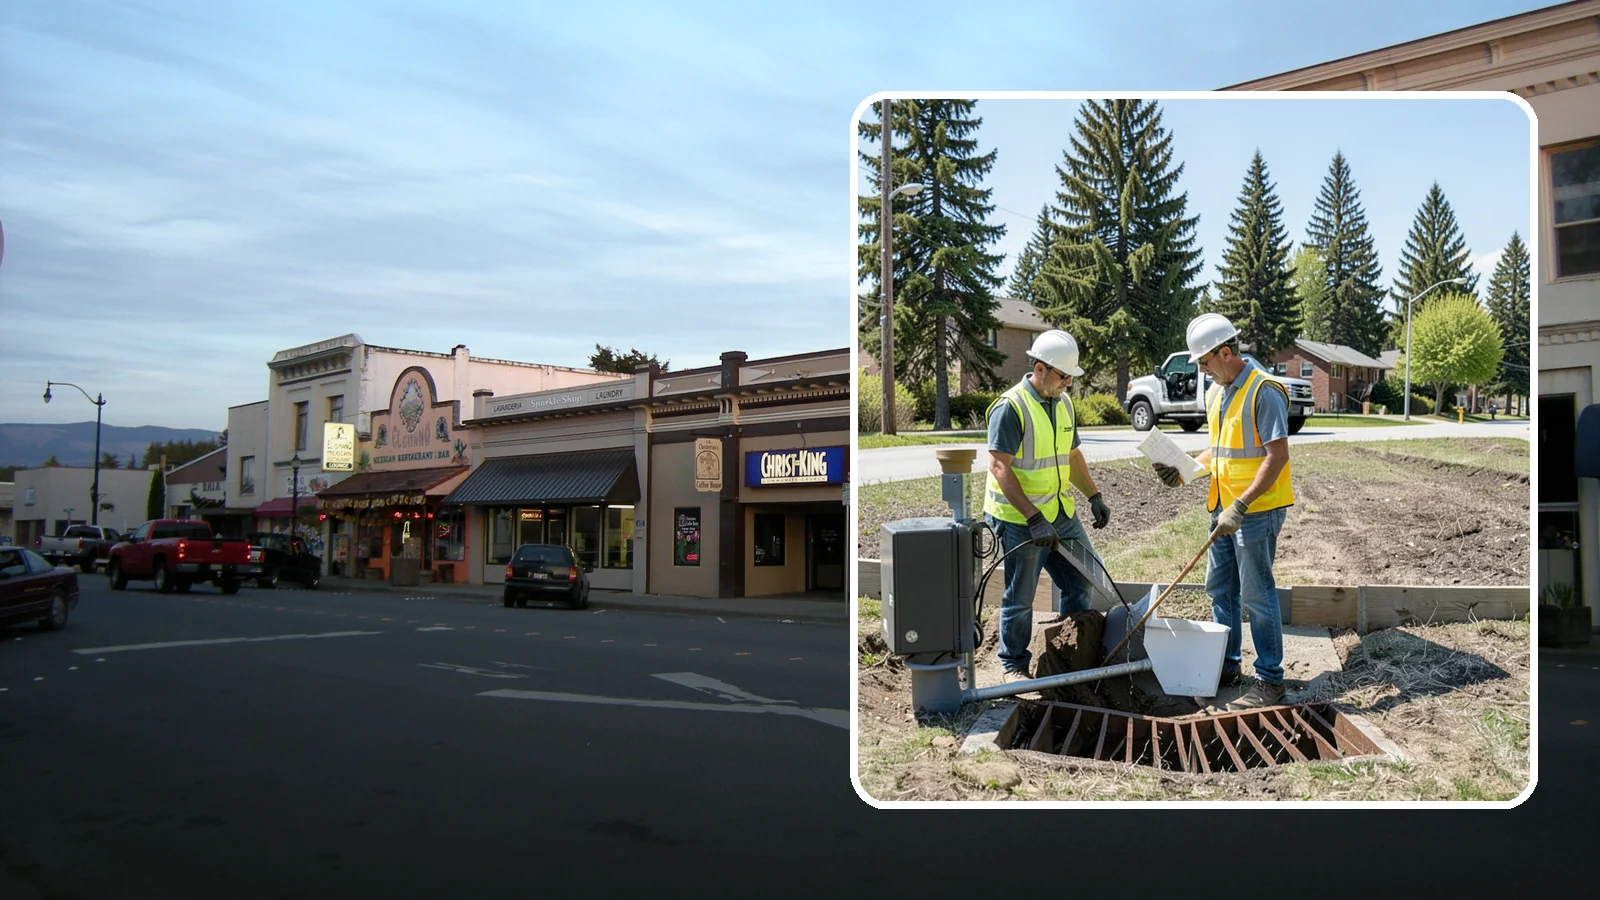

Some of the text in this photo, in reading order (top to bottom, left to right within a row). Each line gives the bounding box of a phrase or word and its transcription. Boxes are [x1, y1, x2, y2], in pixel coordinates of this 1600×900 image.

[595, 388, 624, 400] LAUNDRY
[493, 402, 523, 413] LAVANDERIA
[531, 394, 583, 409] Sparkle Shop
[373, 455, 396, 464] MEXICAN
[397, 451, 434, 462] RESTAURANT
[438, 450, 450, 459] BAR
[761, 450, 827, 478] CHRIST KING
